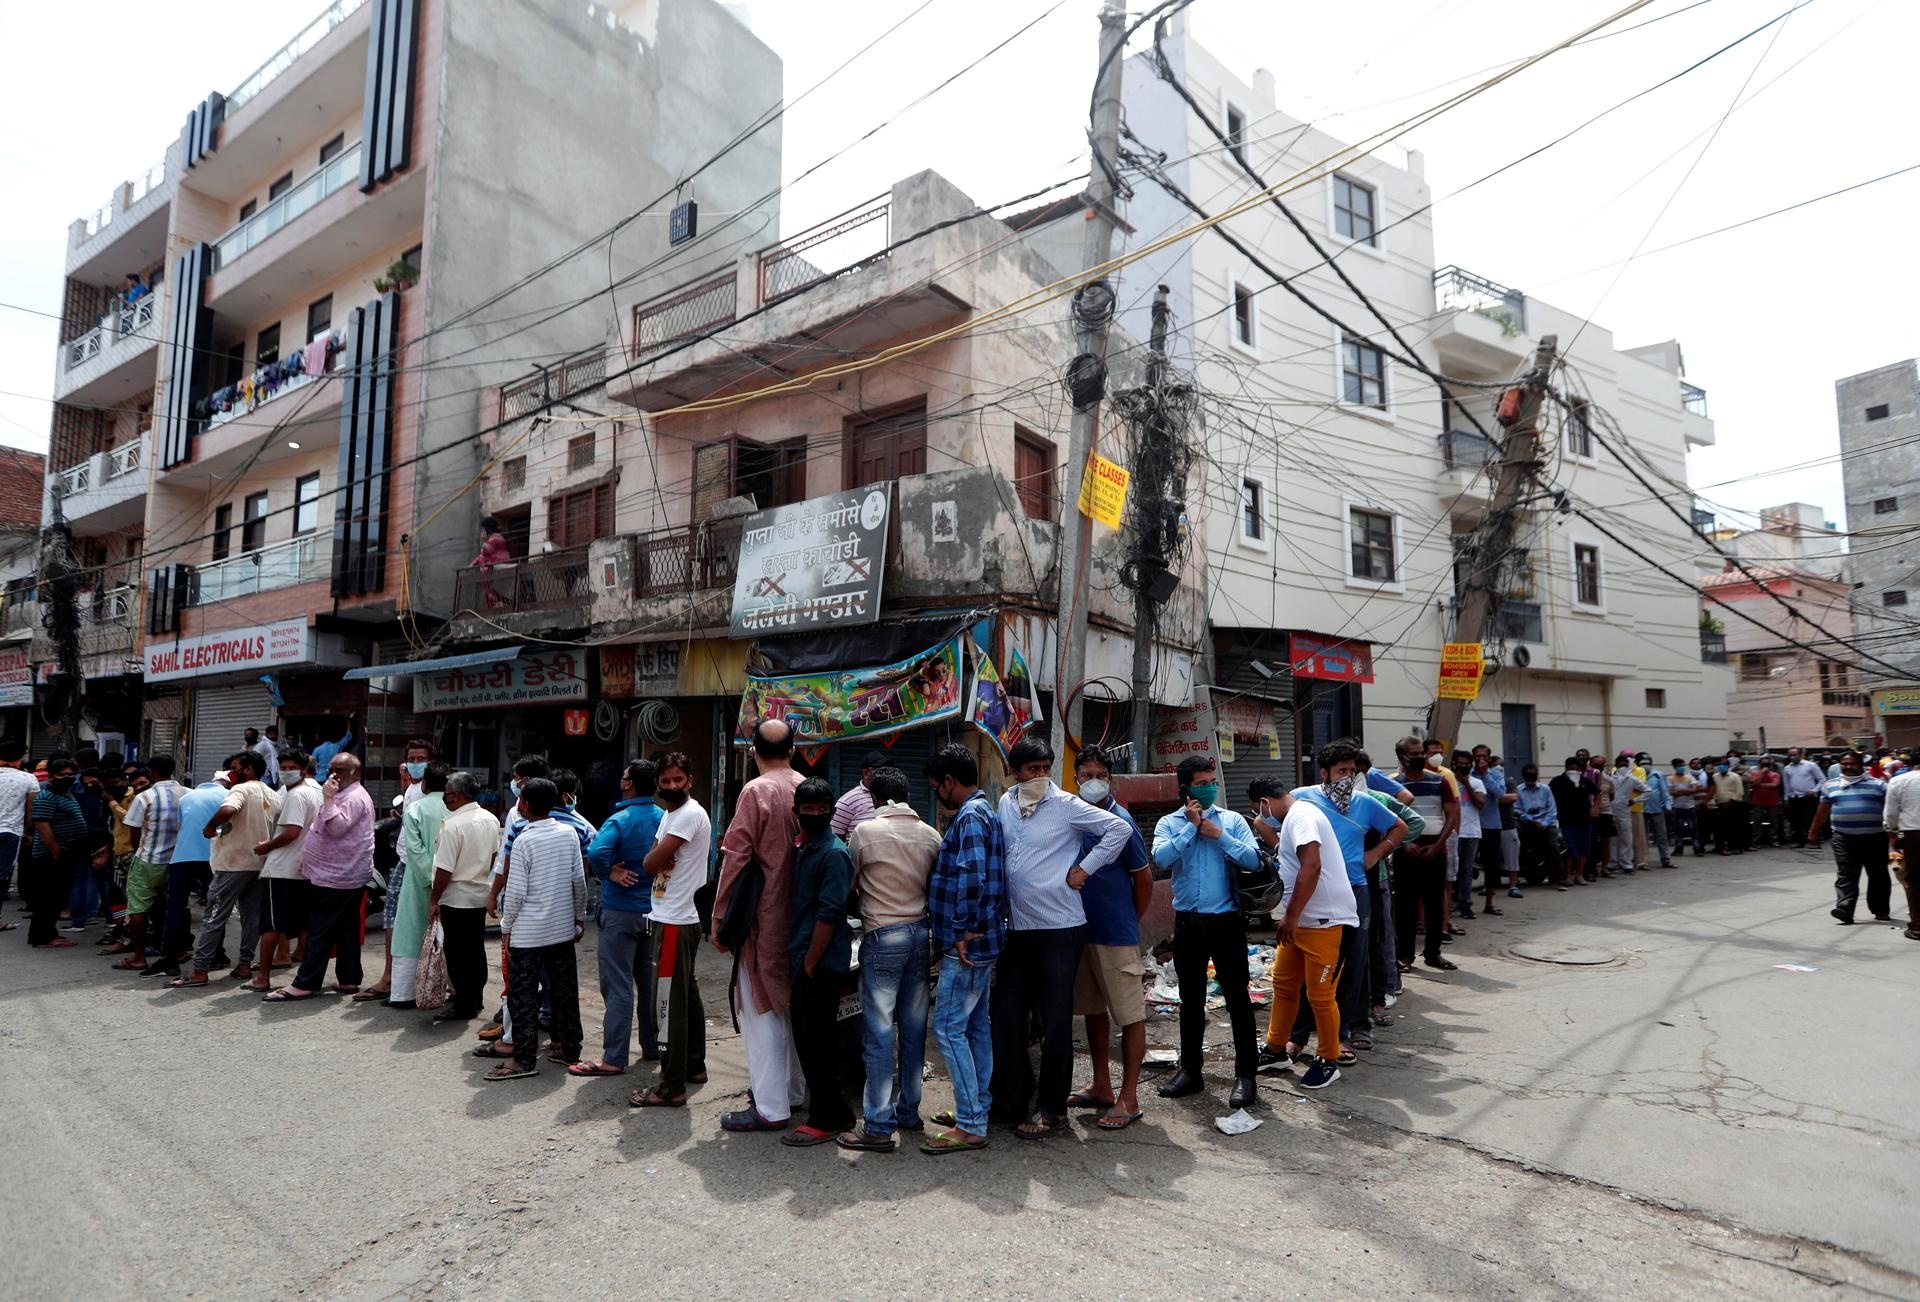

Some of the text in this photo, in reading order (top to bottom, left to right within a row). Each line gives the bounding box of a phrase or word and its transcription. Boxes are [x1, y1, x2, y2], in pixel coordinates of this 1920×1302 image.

[1099, 463, 1126, 488] CLASSES
[745, 499, 862, 556] गुप्ता जी के समोसे
[761, 551, 801, 576] खस्ता
[742, 590, 869, 630] जलेबी भण्डार
[150, 650, 180, 675] SAHIL
[182, 635, 265, 670] ELECTRICALS
[1181, 717, 1198, 732] कार्ड
[1192, 736, 1209, 751] कार्ड
